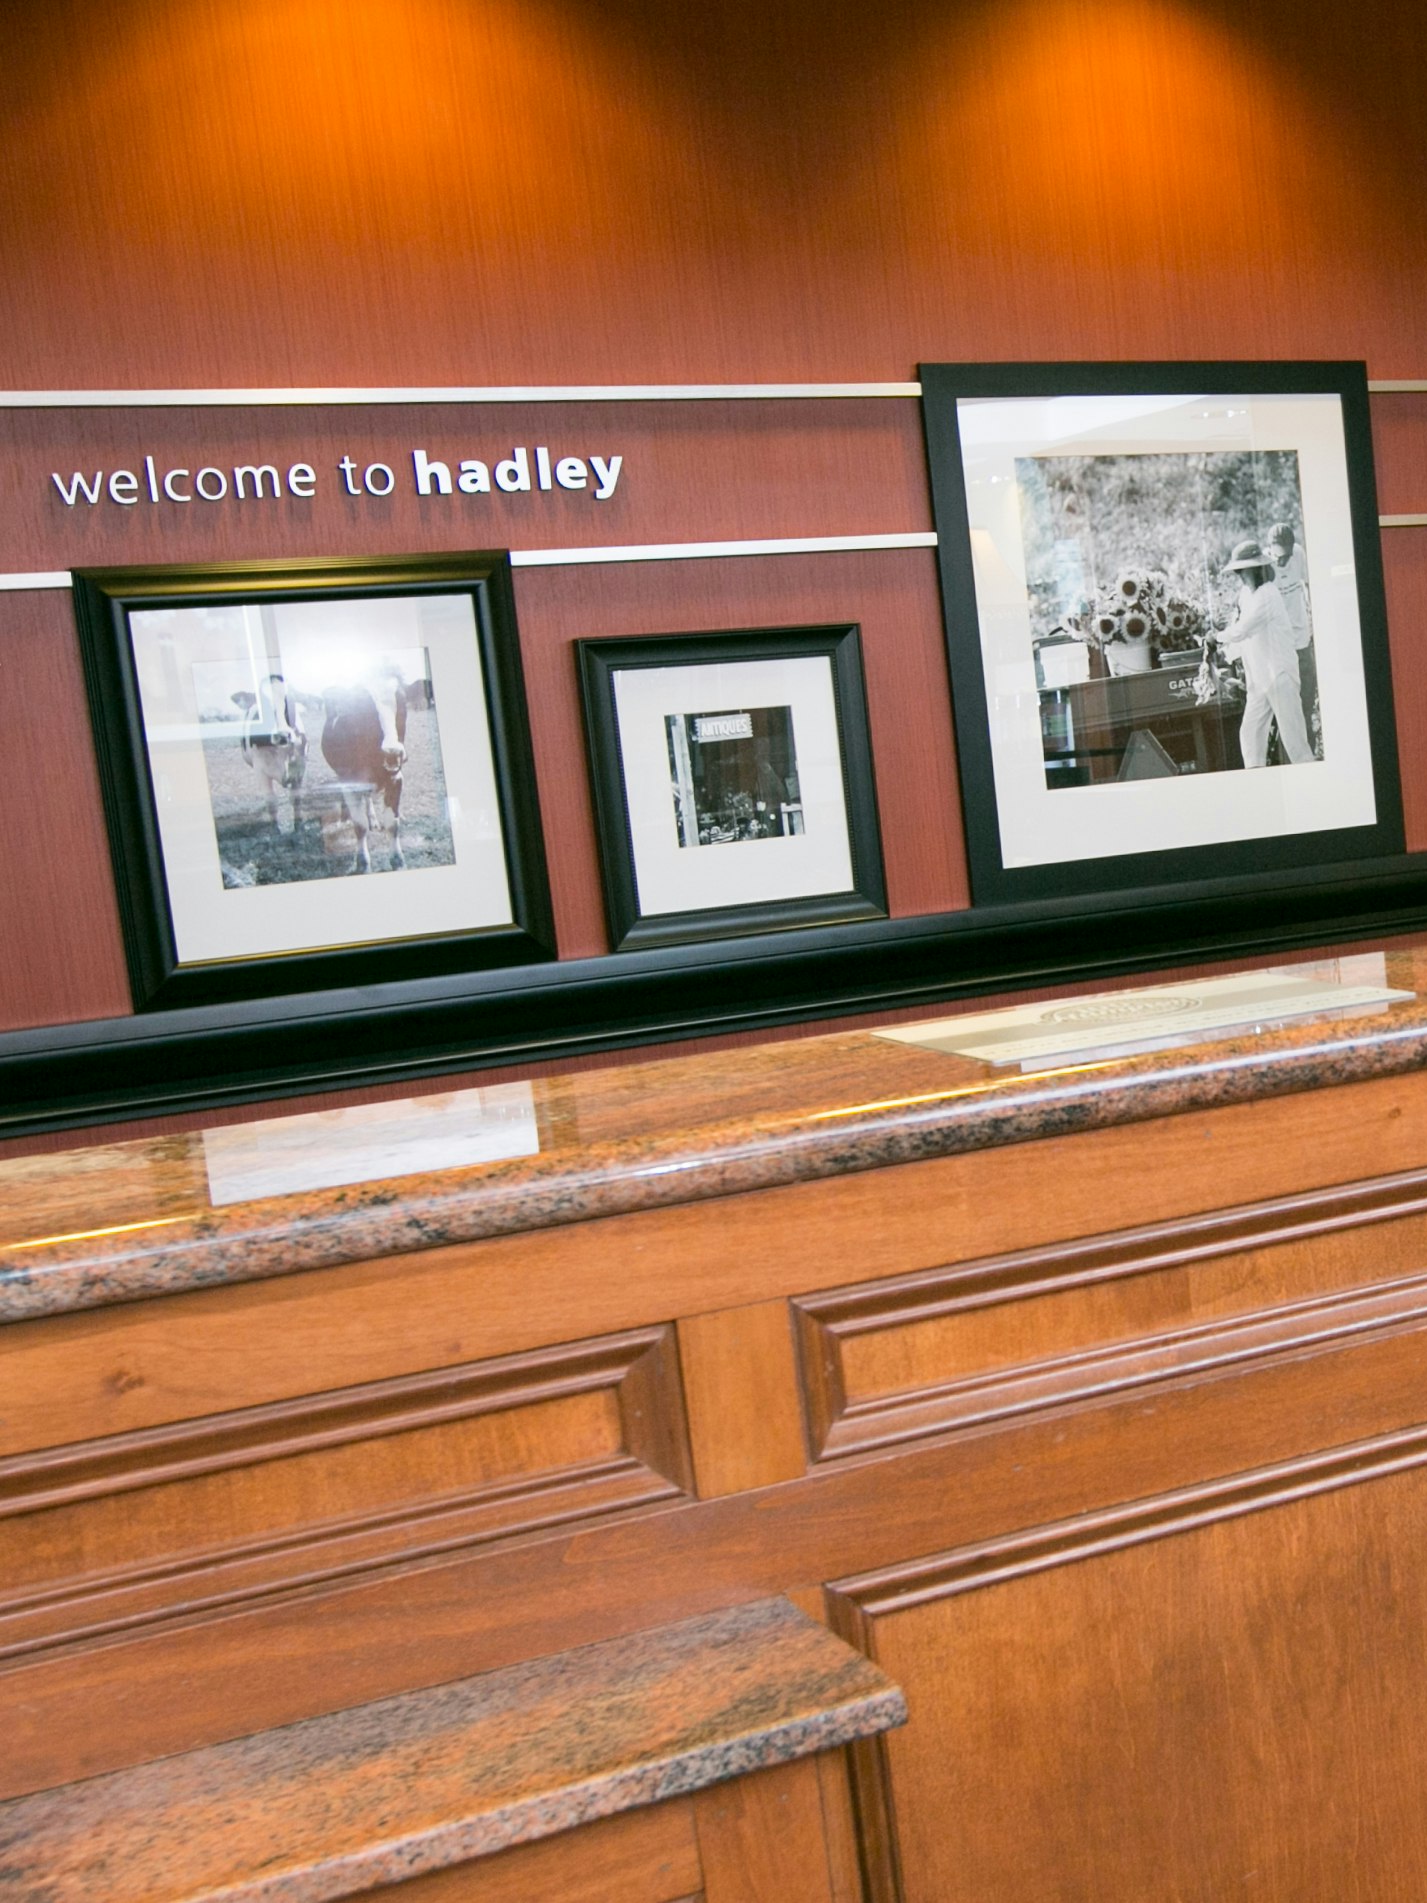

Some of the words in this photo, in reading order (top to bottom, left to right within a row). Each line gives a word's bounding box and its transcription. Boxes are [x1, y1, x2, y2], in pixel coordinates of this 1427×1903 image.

[51, 455, 316, 506] welcome
[338, 455, 396, 496] to
[412, 447, 623, 500] hadley
[1168, 676, 1199, 690] GAT
[701, 719, 748, 737] ANTIQUES
